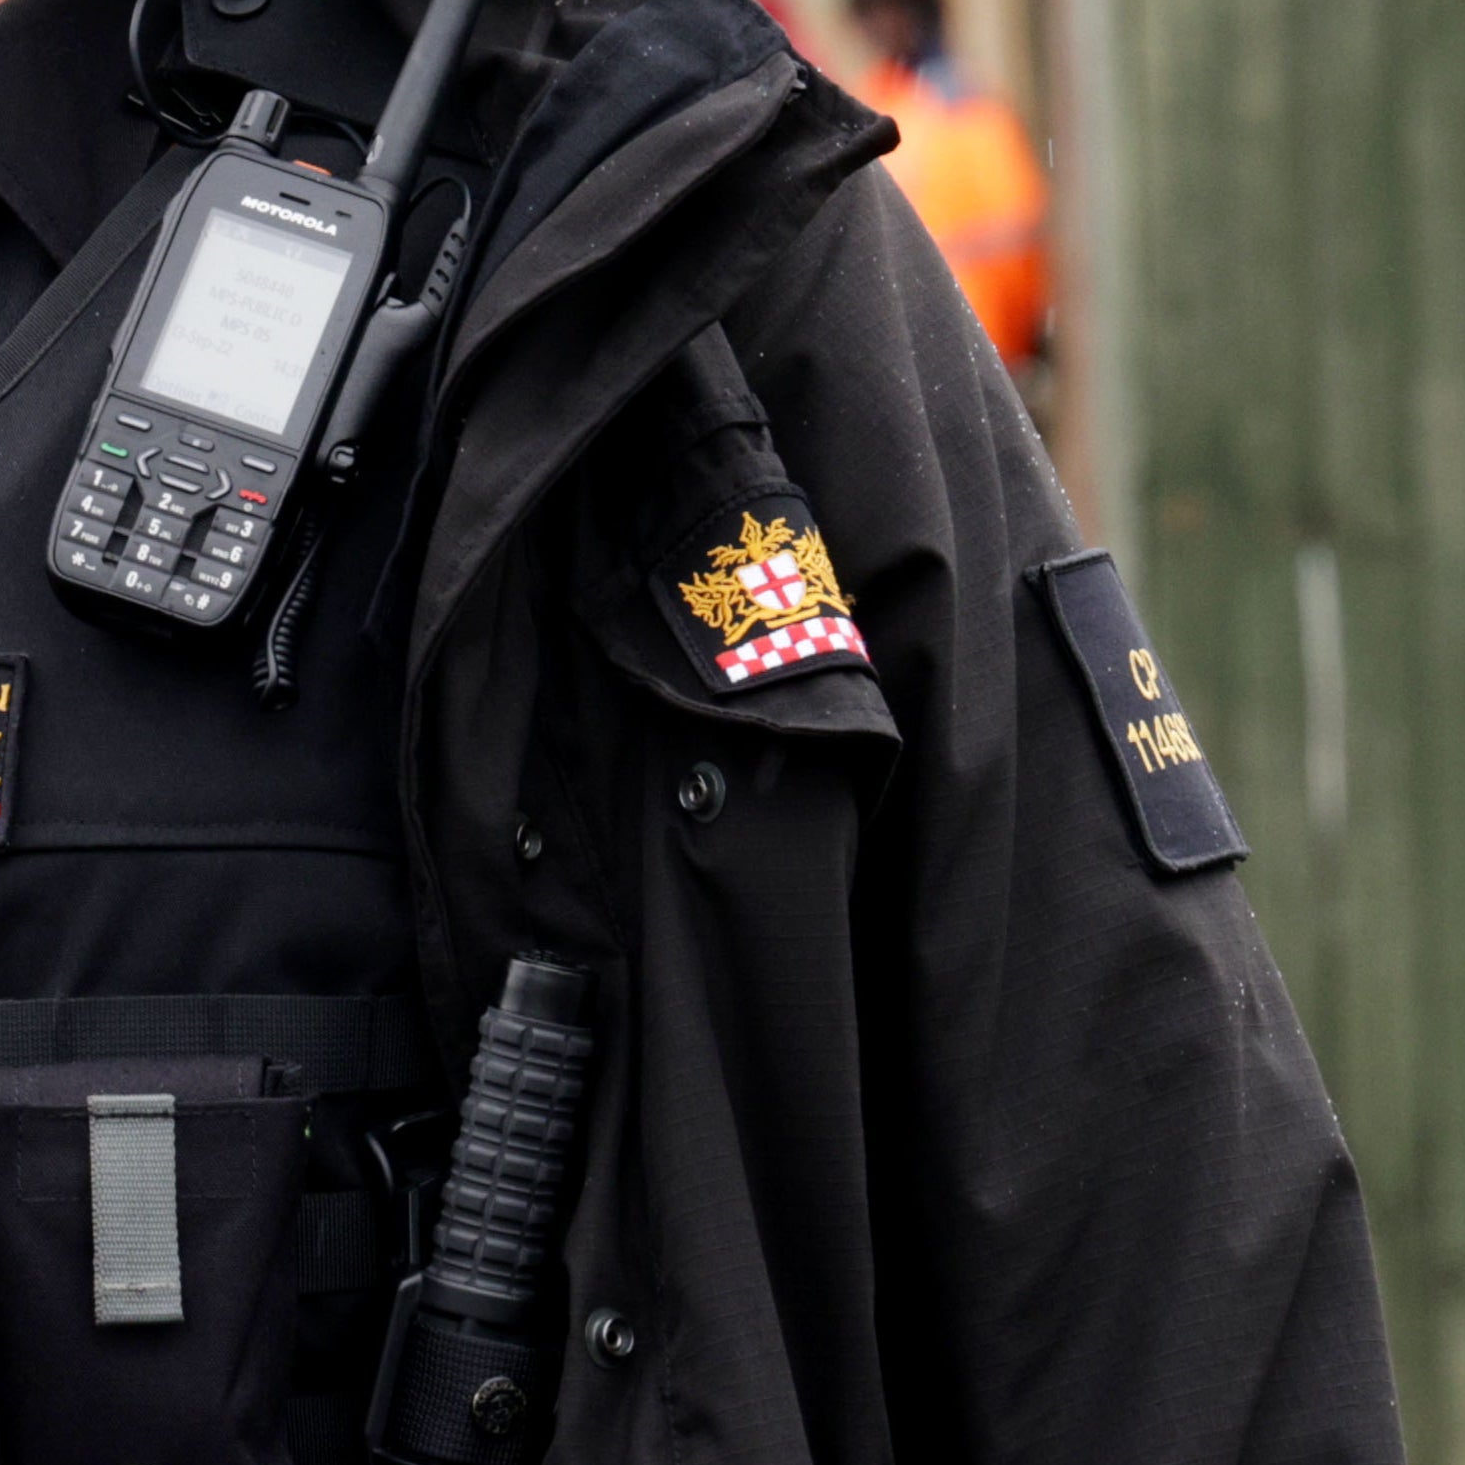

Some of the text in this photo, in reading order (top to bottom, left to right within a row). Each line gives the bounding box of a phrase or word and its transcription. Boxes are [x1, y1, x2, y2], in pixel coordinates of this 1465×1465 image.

[240, 195, 338, 236] MOTOROLA
[93, 470, 104, 487] 1
[81, 494, 93, 512] 4
[158, 493, 172, 510] 2
[70, 520, 83, 537] 7
[148, 518, 162, 535] 5
[240, 521, 254, 538] 3
[137, 544, 151, 561] 8
[229, 546, 243, 563] 6
[219, 571, 233, 588] 9
